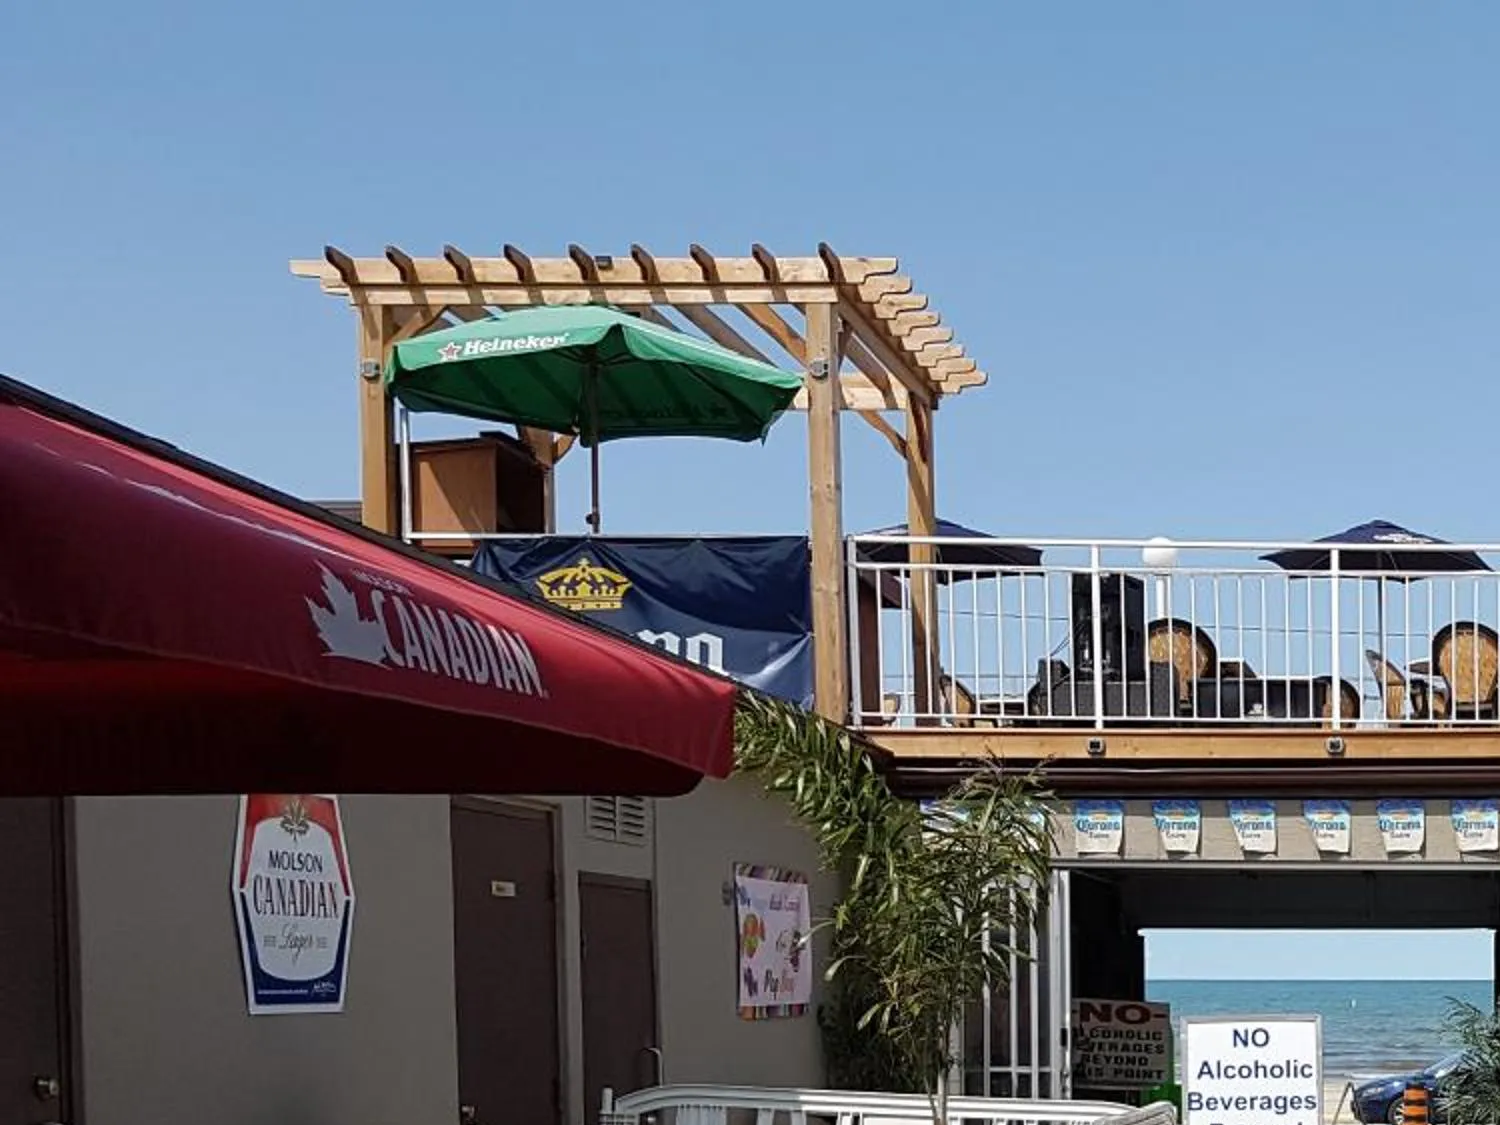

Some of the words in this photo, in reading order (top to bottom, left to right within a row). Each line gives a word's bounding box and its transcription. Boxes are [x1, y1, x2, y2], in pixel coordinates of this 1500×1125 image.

[371, 589, 544, 698] CANADIAN
[1077, 819, 1120, 832] Corona
[1311, 820, 1346, 832] orona
[1379, 819, 1421, 832] Corona
[268, 850, 323, 873] MOLSON
[253, 874, 339, 919] CANADIAN
[1233, 1028, 1270, 1048] NO
[1113, 1068, 1166, 1080] POINT
[1197, 1059, 1314, 1080] Alcoholic
[1187, 1091, 1317, 1115] Beverages
